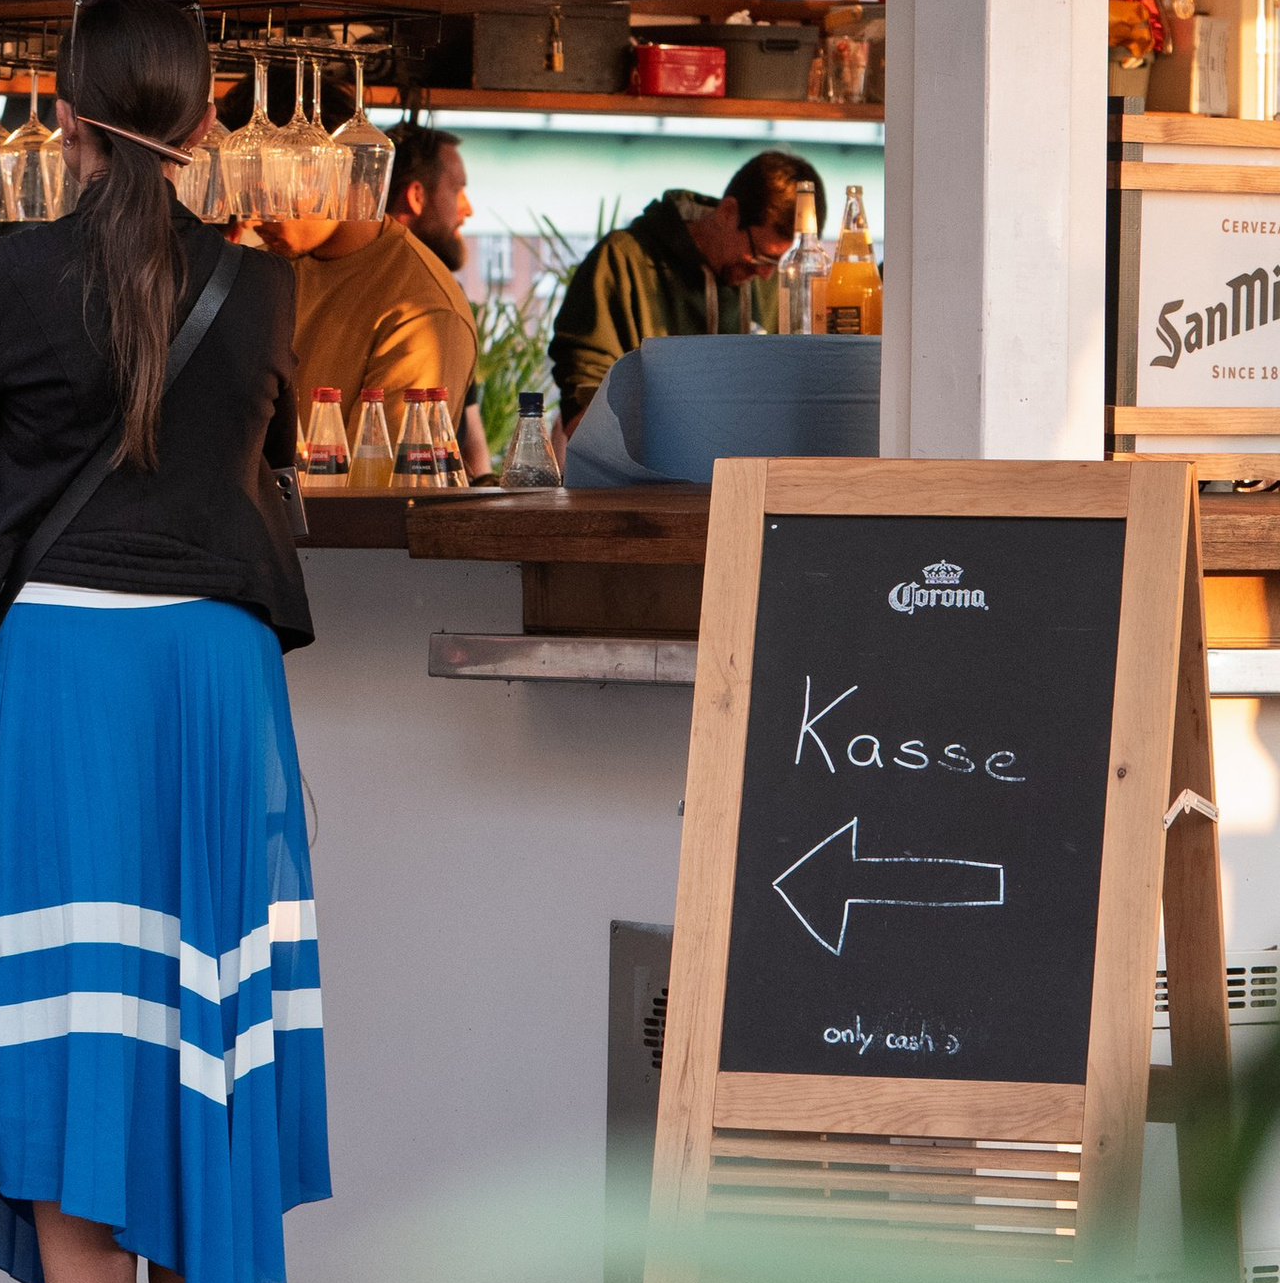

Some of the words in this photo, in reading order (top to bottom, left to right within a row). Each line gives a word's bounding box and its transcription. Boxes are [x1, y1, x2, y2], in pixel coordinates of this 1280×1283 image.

[1221, 219, 1280, 234] CERVEZ
[1212, 365, 1255, 379] SINCE
[888, 581, 986, 615] Corona
[795, 675, 1026, 782] Kasse
[823, 1015, 874, 1055] only
[885, 1019, 935, 1052] cash
